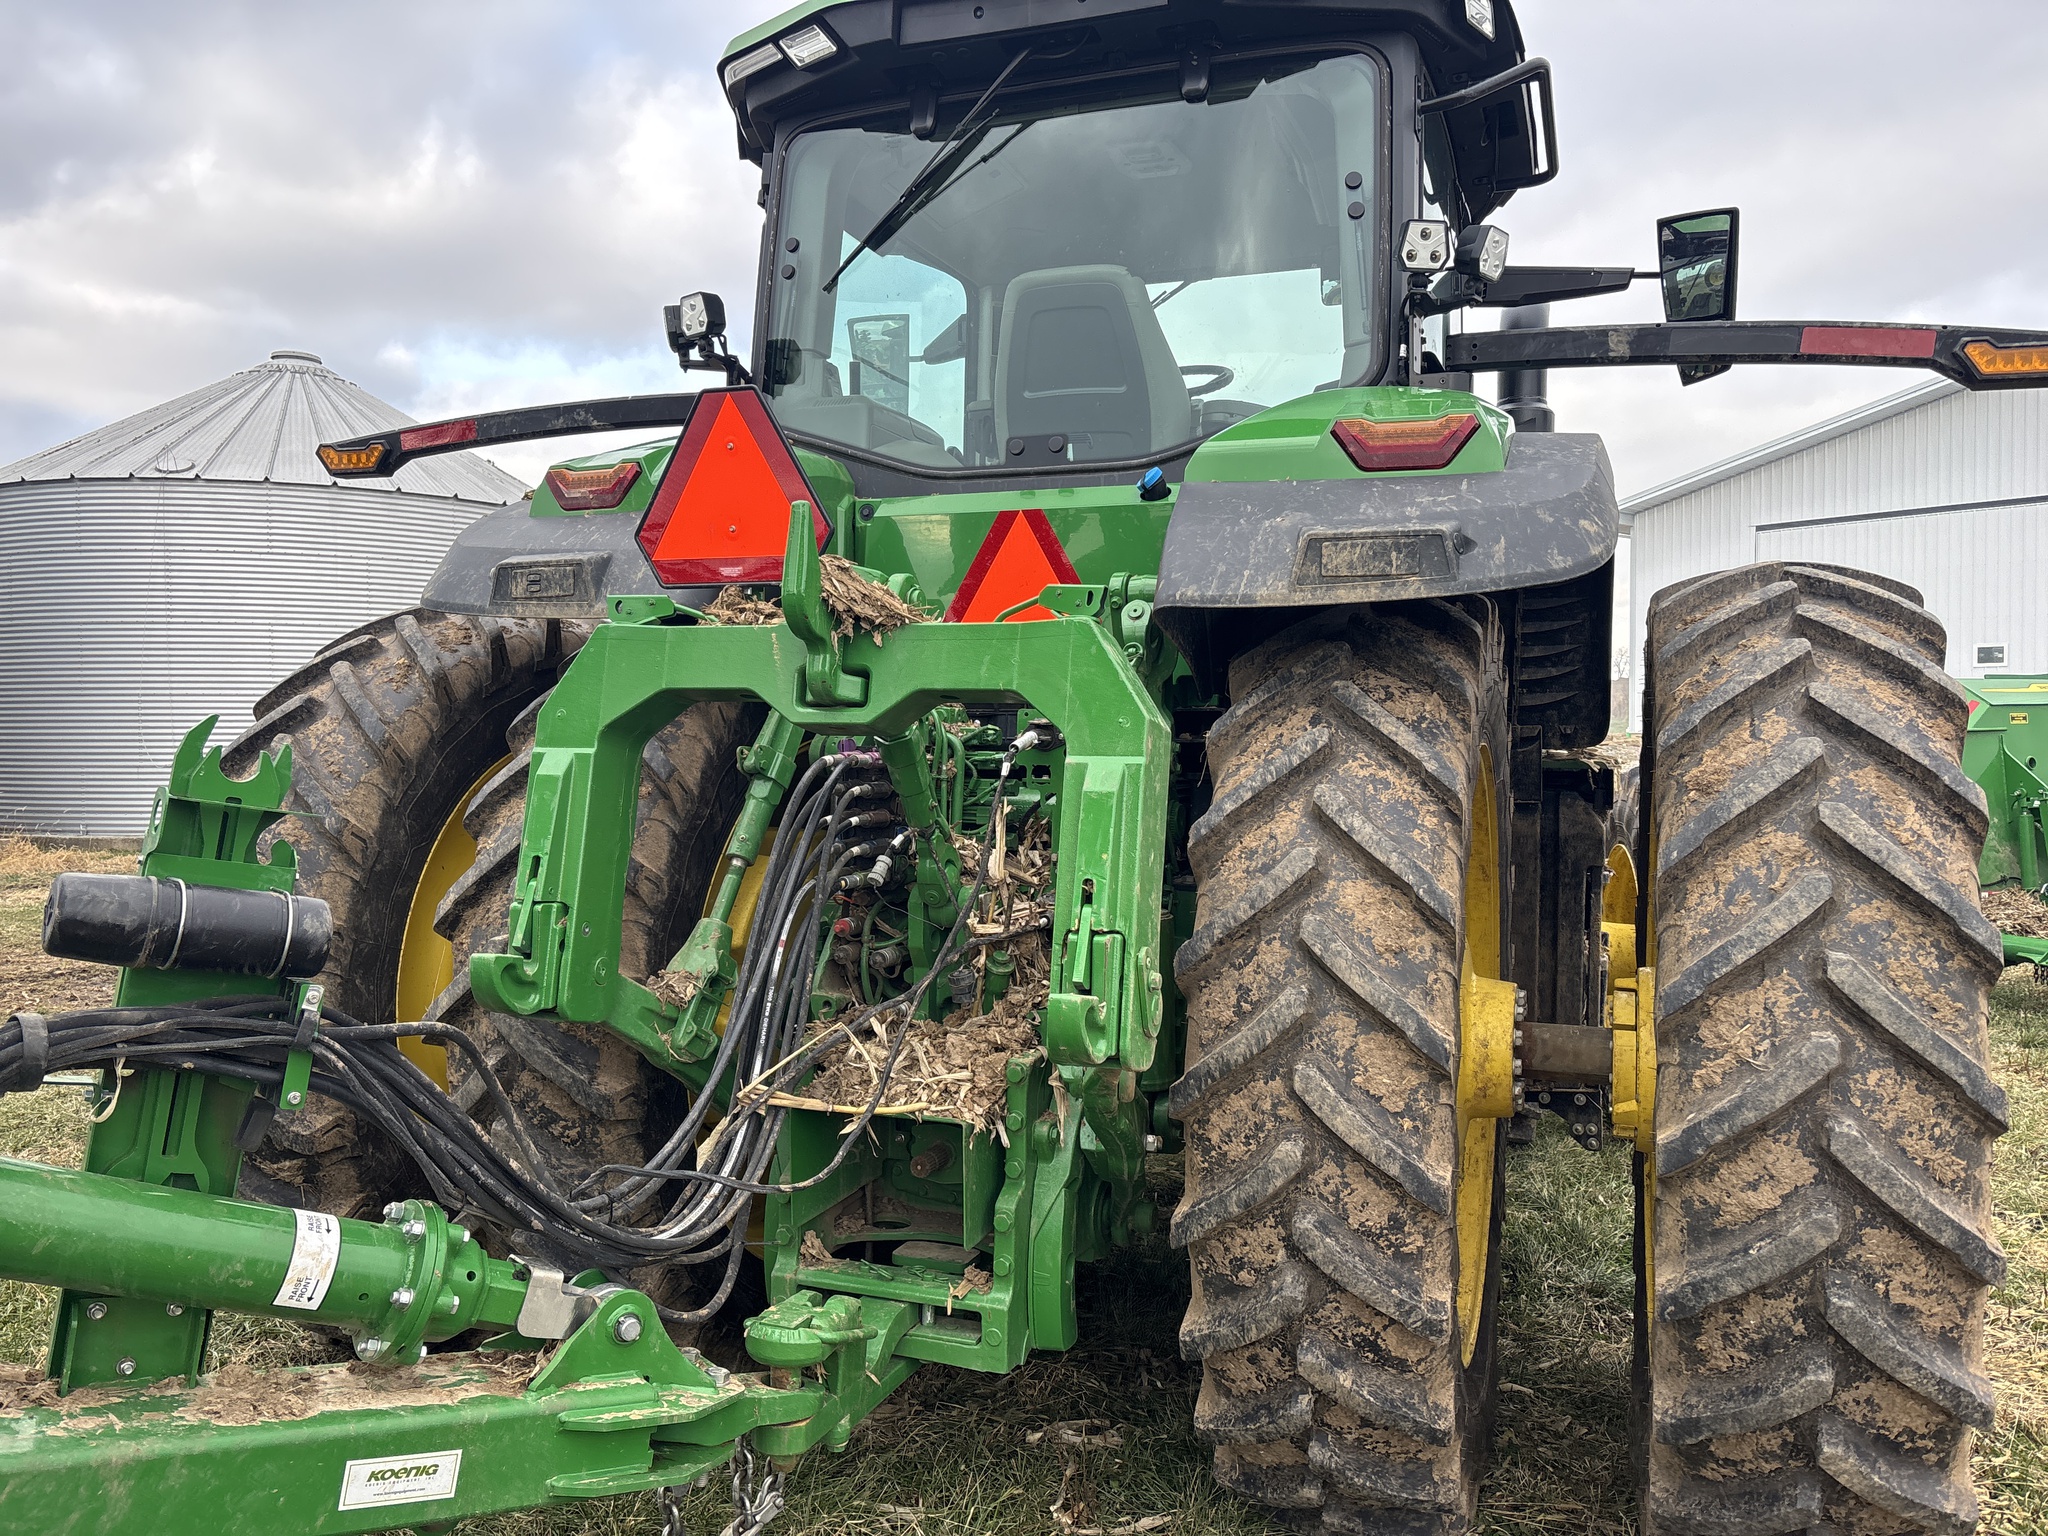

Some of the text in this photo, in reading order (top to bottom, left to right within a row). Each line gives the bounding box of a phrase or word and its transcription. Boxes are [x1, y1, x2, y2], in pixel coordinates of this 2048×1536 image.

[306, 1215, 314, 1231] RAISE
[313, 1215, 323, 1233] FRONT
[288, 1277, 304, 1301] RAISE
[295, 1275, 312, 1303] FRONT
